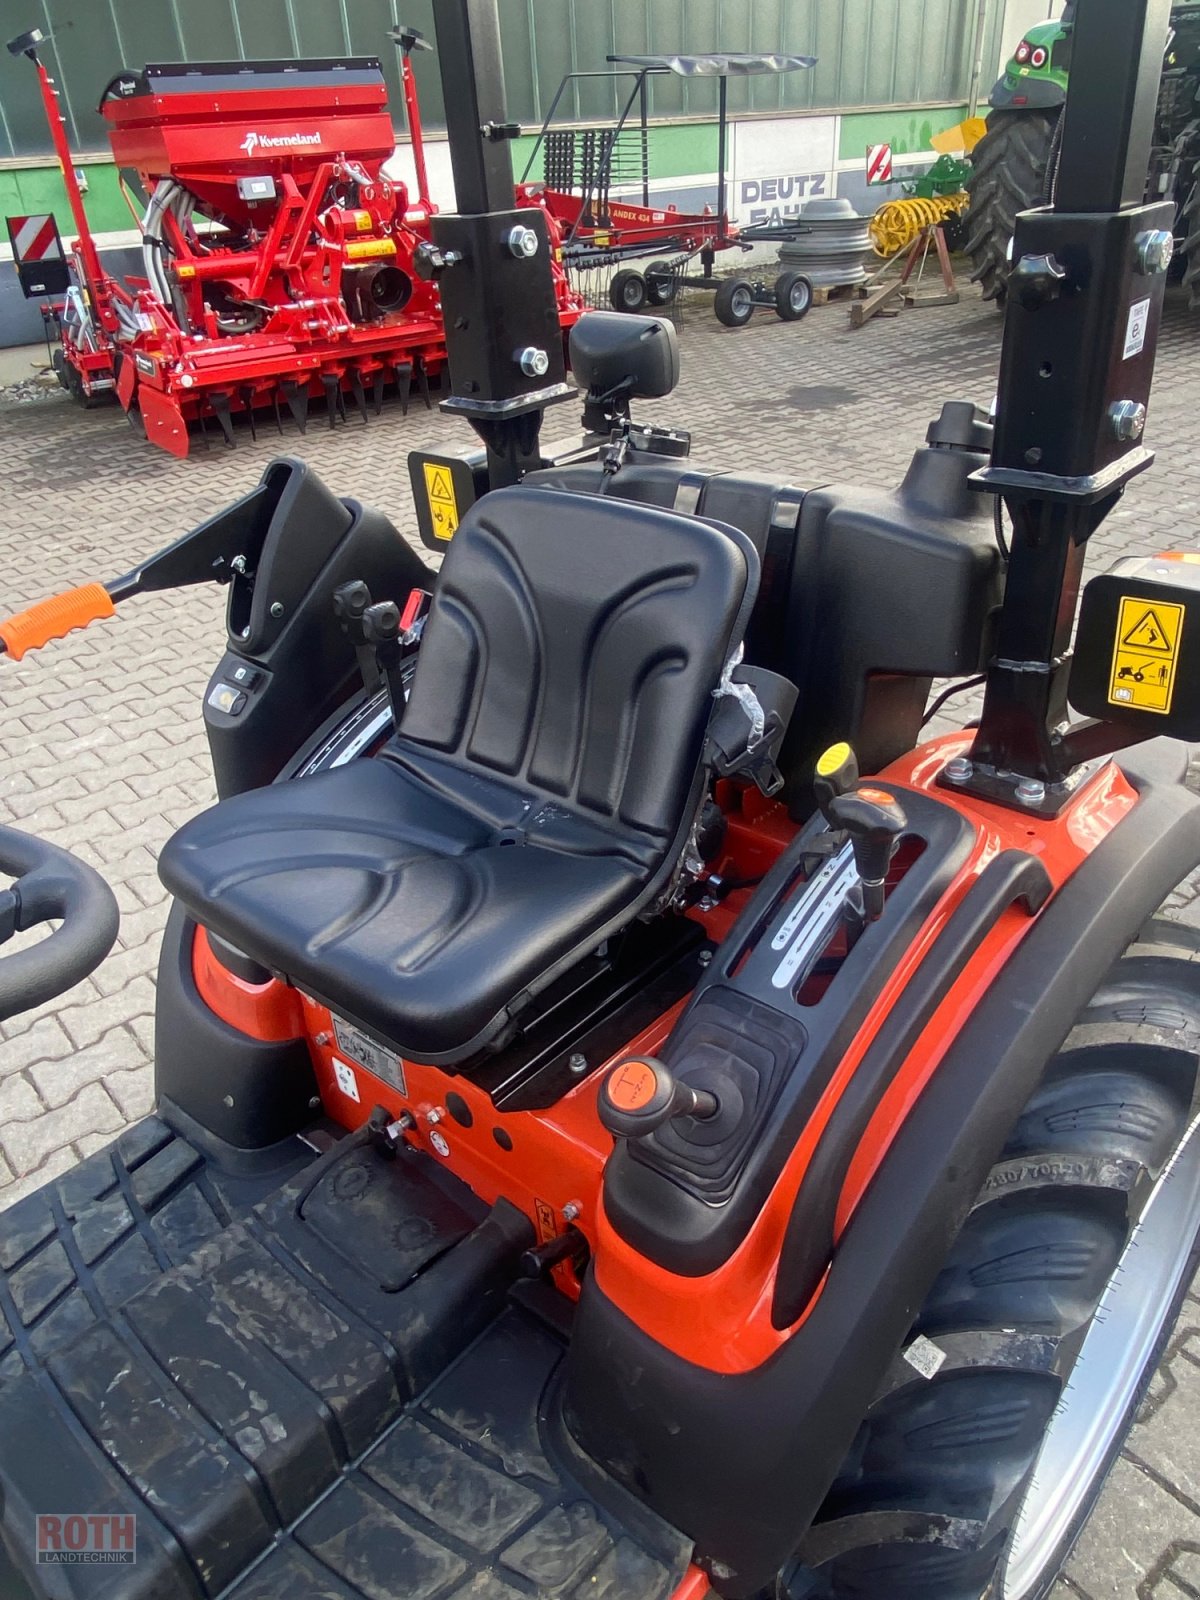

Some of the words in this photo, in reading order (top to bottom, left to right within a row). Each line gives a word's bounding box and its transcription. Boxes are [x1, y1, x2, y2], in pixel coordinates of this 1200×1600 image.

[259, 131, 321, 147] Kverneland
[741, 173, 826, 204] DEUTZ
[613, 209, 637, 221] ANDEX
